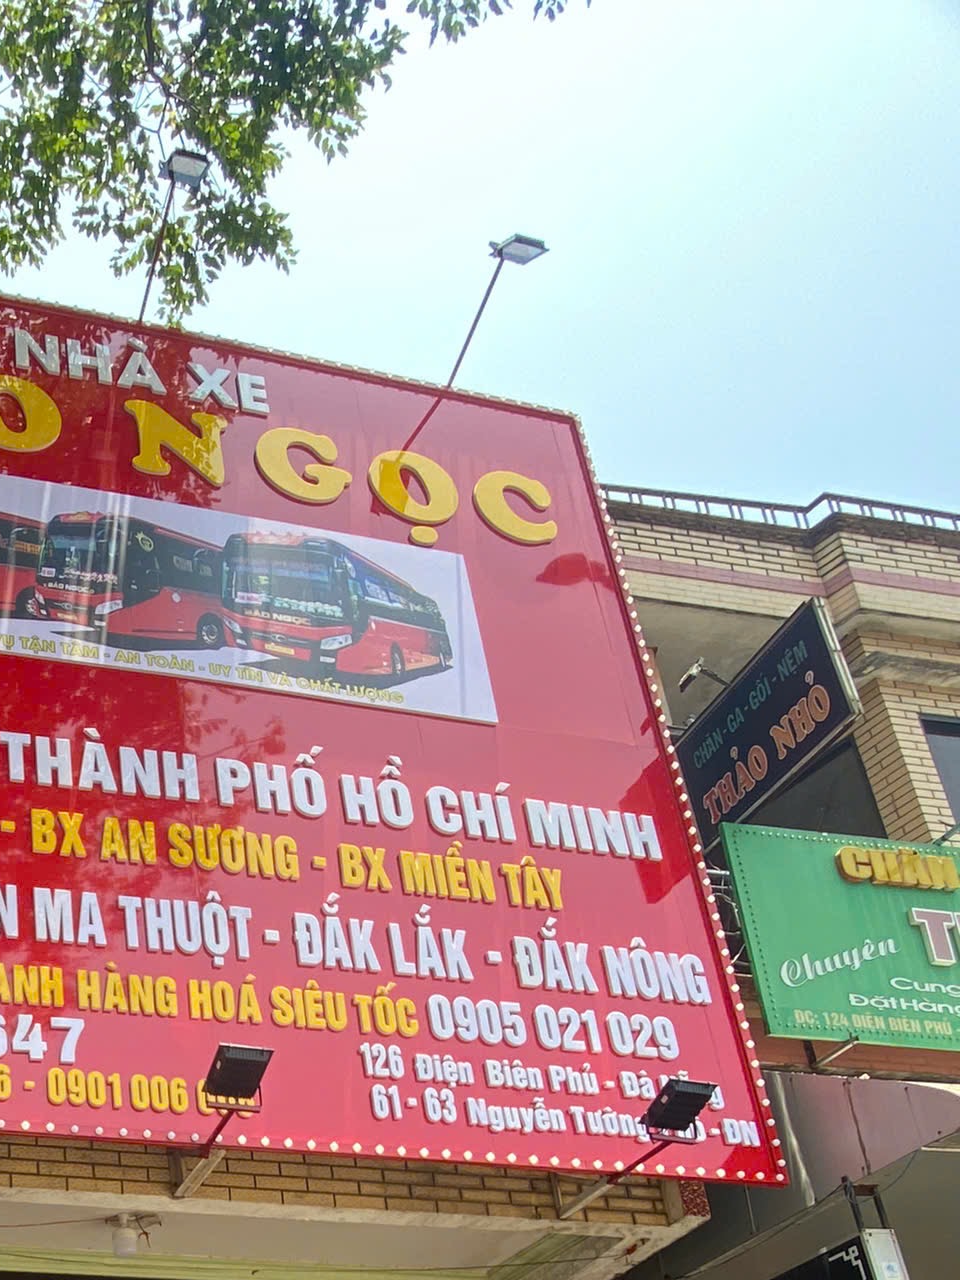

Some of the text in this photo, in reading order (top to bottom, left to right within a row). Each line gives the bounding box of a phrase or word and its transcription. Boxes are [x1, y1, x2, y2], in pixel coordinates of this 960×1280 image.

[14, 328, 270, 417] NHÀ XE
[124, 400, 557, 546] NGỌC
[114, 653, 141, 666] AN
[146, 650, 195, 672] TOÀN
[209, 662, 232, 677] UY
[268, 670, 292, 689] VÀ
[703, 670, 830, 824] THẢO NHỎ
[215, 745, 327, 819] PHỐ
[339, 755, 414, 830] HỒ
[426, 782, 517, 843] CHÍ
[524, 798, 663, 862] MINH
[31, 808, 86, 858] BX
[100, 816, 158, 866] AN
[169, 822, 299, 881] SƯƠNG
[338, 843, 392, 891] BX
[399, 840, 496, 903] MIỀN
[500, 855, 564, 912] TÂY
[33, 886, 107, 948] MA
[118, 890, 252, 969] THUỘT
[293, 892, 382, 973] ĐẮK
[388, 904, 474, 982] LẮK
[512, 916, 599, 995] ĐẮK
[601, 936, 712, 1006] NÔNG
[780, 938, 901, 988] Chuyên
[77, 961, 177, 1018] HÀNG
[189, 973, 262, 1025] HOÁ
[270, 979, 348, 1032] SIÊU
[353, 982, 419, 1038] TỐC
[427, 993, 528, 1048] 0905
[534, 1004, 602, 1055] 021
[606, 1011, 680, 1061] 029
[823, 1012, 849, 1027] 124
[888, 1013, 922, 1033] BIÊN
[47, 1067, 122, 1110] 0901
[130, 1073, 189, 1115] 006
[360, 1042, 405, 1079] 126
[414, 1053, 474, 1088] Điện
[484, 1059, 544, 1091] Biên
[548, 1062, 600, 1095] Phủ
[371, 1084, 403, 1120] 61
[423, 1087, 457, 1124] 63
[466, 1096, 567, 1134] Nguyễn
[722, 1118, 761, 1147] ĐN
